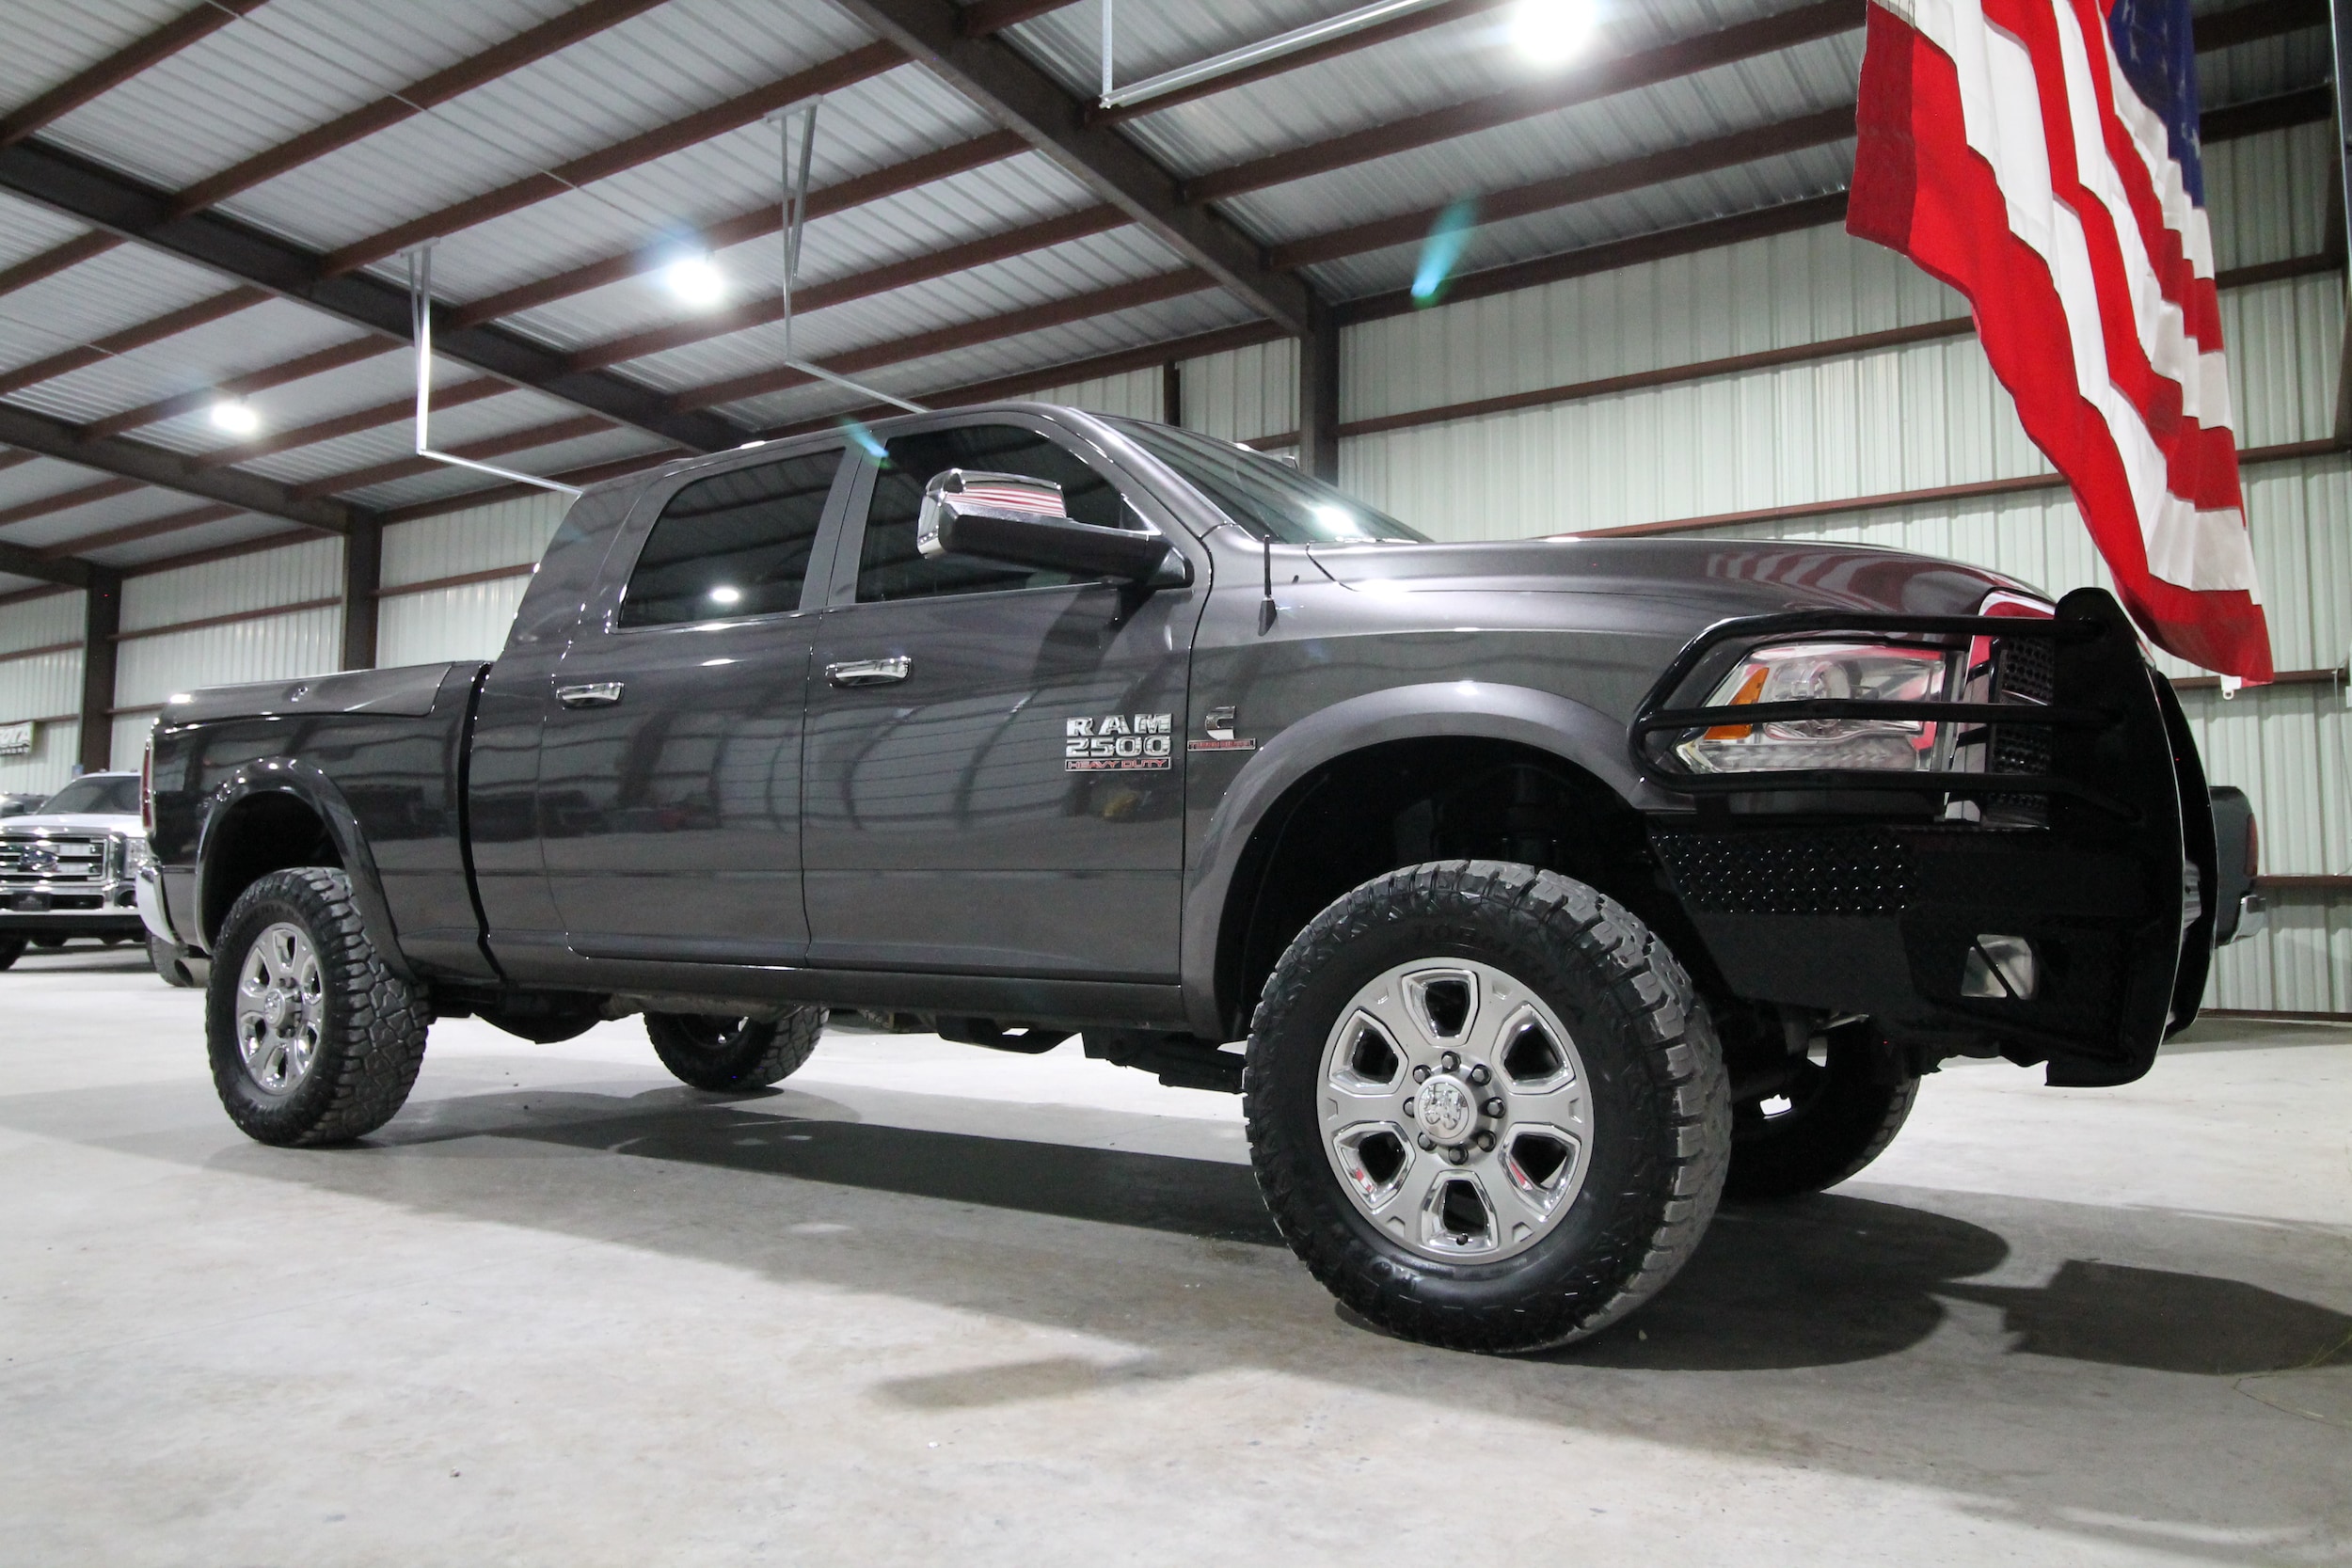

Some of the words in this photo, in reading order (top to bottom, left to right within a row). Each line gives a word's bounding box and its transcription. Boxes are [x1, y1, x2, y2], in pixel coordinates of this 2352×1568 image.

[1066, 713, 1172, 736] RAM
[1066, 736, 1171, 758] 2500
[1068, 760, 1120, 769] HEAVY
[1120, 759, 1168, 768] DUTY
